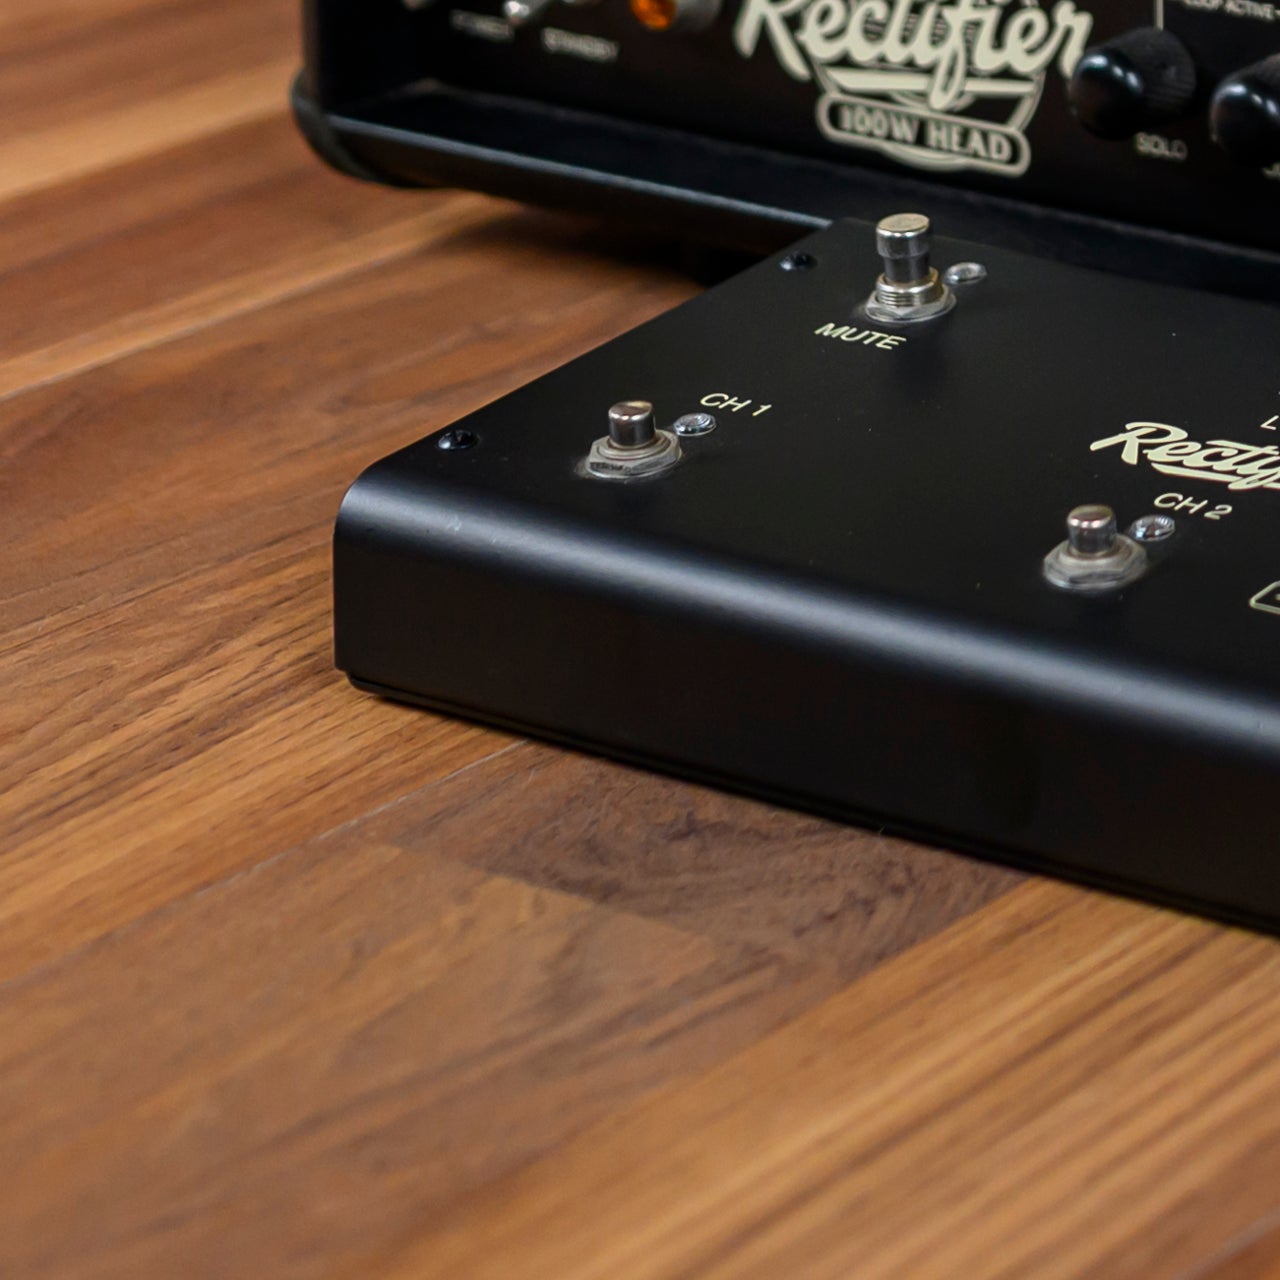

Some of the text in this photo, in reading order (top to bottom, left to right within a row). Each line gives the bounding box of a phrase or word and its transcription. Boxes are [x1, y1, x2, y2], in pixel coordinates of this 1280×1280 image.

[838, 105, 1013, 162] 100W HEAD
[1136, 132, 1188, 160] SOLO
[814, 322, 907, 350] MUTE
[700, 392, 772, 417] CH 1
[1153, 492, 1233, 520] CH 2
